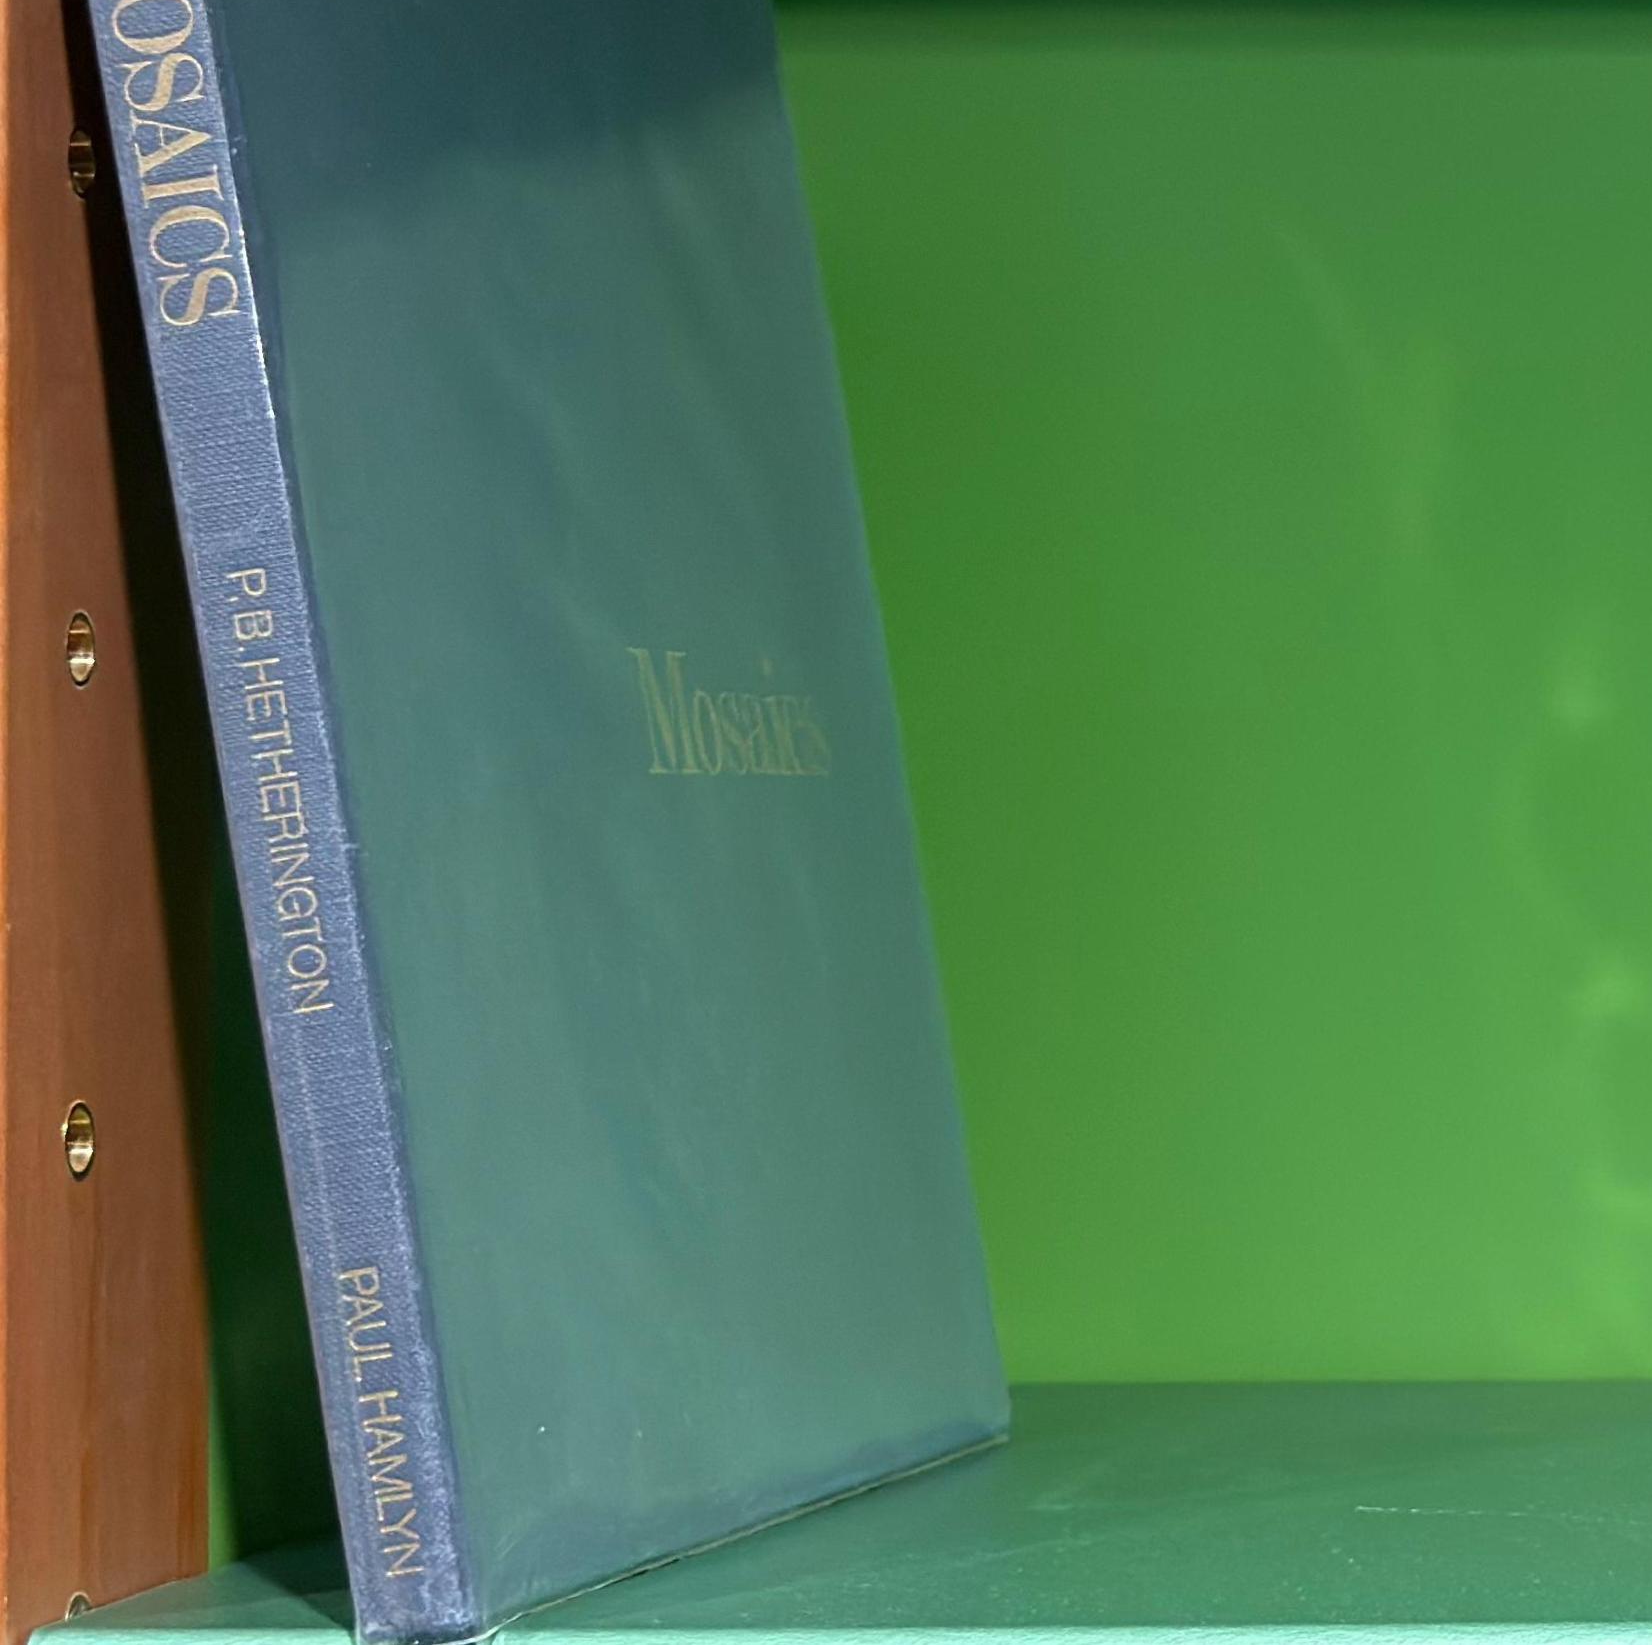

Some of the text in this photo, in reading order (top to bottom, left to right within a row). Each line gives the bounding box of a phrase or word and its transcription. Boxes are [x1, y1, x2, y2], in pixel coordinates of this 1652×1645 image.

[236, 655, 332, 1016] HETHERINGTON
[337, 1266, 424, 1578] PAUL HAMLYN
